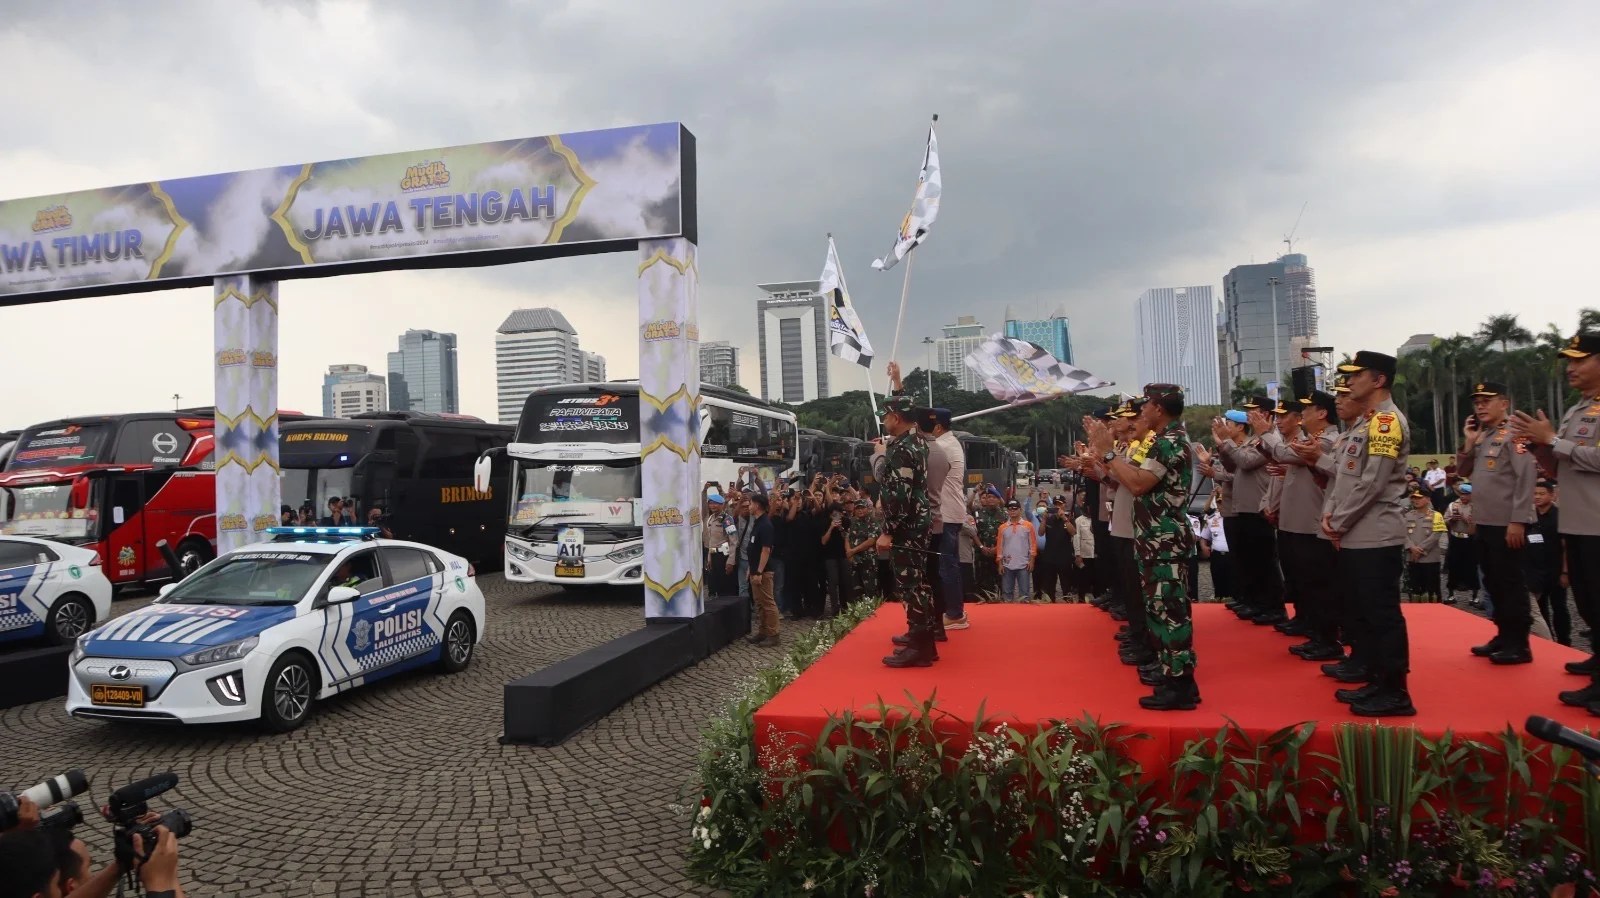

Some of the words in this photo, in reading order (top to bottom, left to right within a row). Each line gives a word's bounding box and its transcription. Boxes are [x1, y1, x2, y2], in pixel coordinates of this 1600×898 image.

[405, 160, 447, 179] Mudik
[303, 201, 404, 241] JAWA
[409, 185, 556, 232] TENGAH
[0, 240, 49, 275] WA
[52, 228, 145, 268] TIMUR
[549, 407, 622, 417] PARIWISATA
[286, 432, 312, 443] KORPS
[313, 432, 349, 442] BRIMOB
[560, 543, 582, 557] A11
[374, 608, 422, 641] POLISI
[374, 639, 394, 650] LALU
[396, 629, 422, 642] LINTAS
